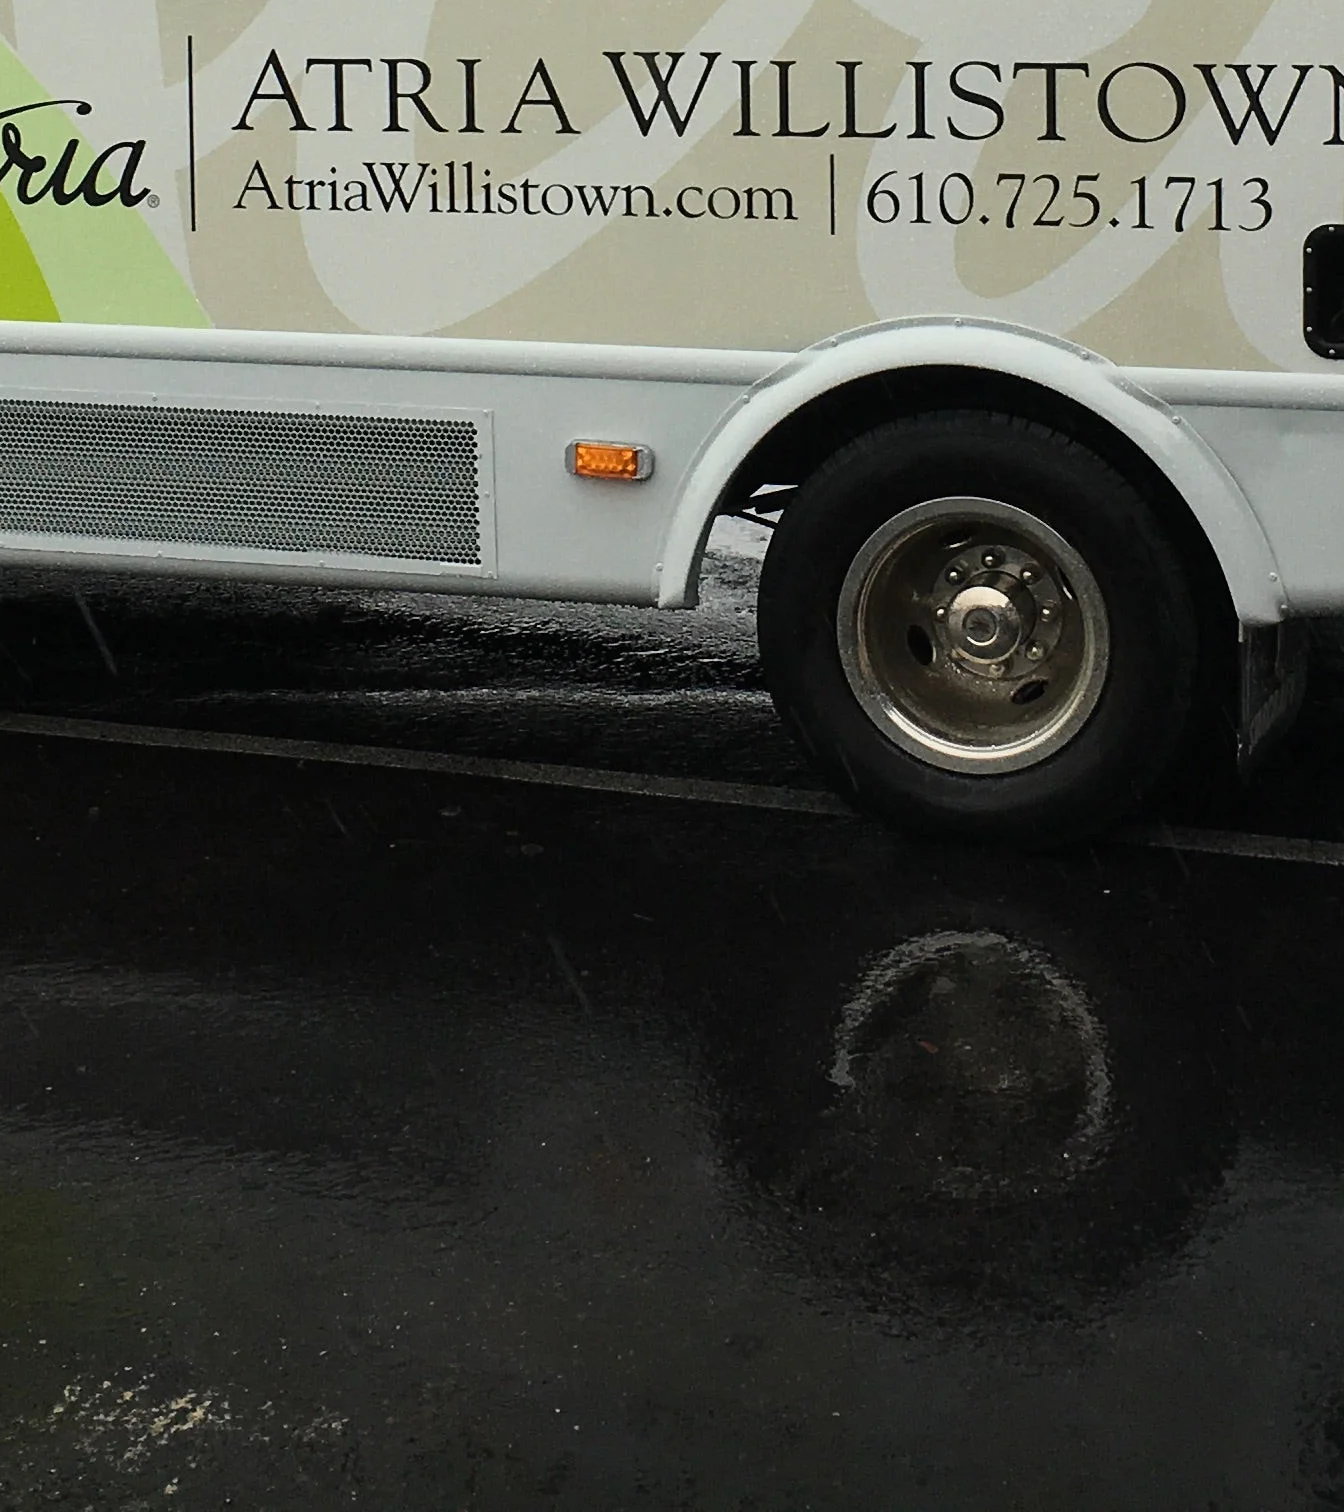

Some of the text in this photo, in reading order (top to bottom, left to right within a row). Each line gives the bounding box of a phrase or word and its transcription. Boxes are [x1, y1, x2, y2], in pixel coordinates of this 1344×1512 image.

[231, 48, 582, 135] ATRIA
[231, 158, 1274, 234] AtriaWillistown.com 610.725.1713
